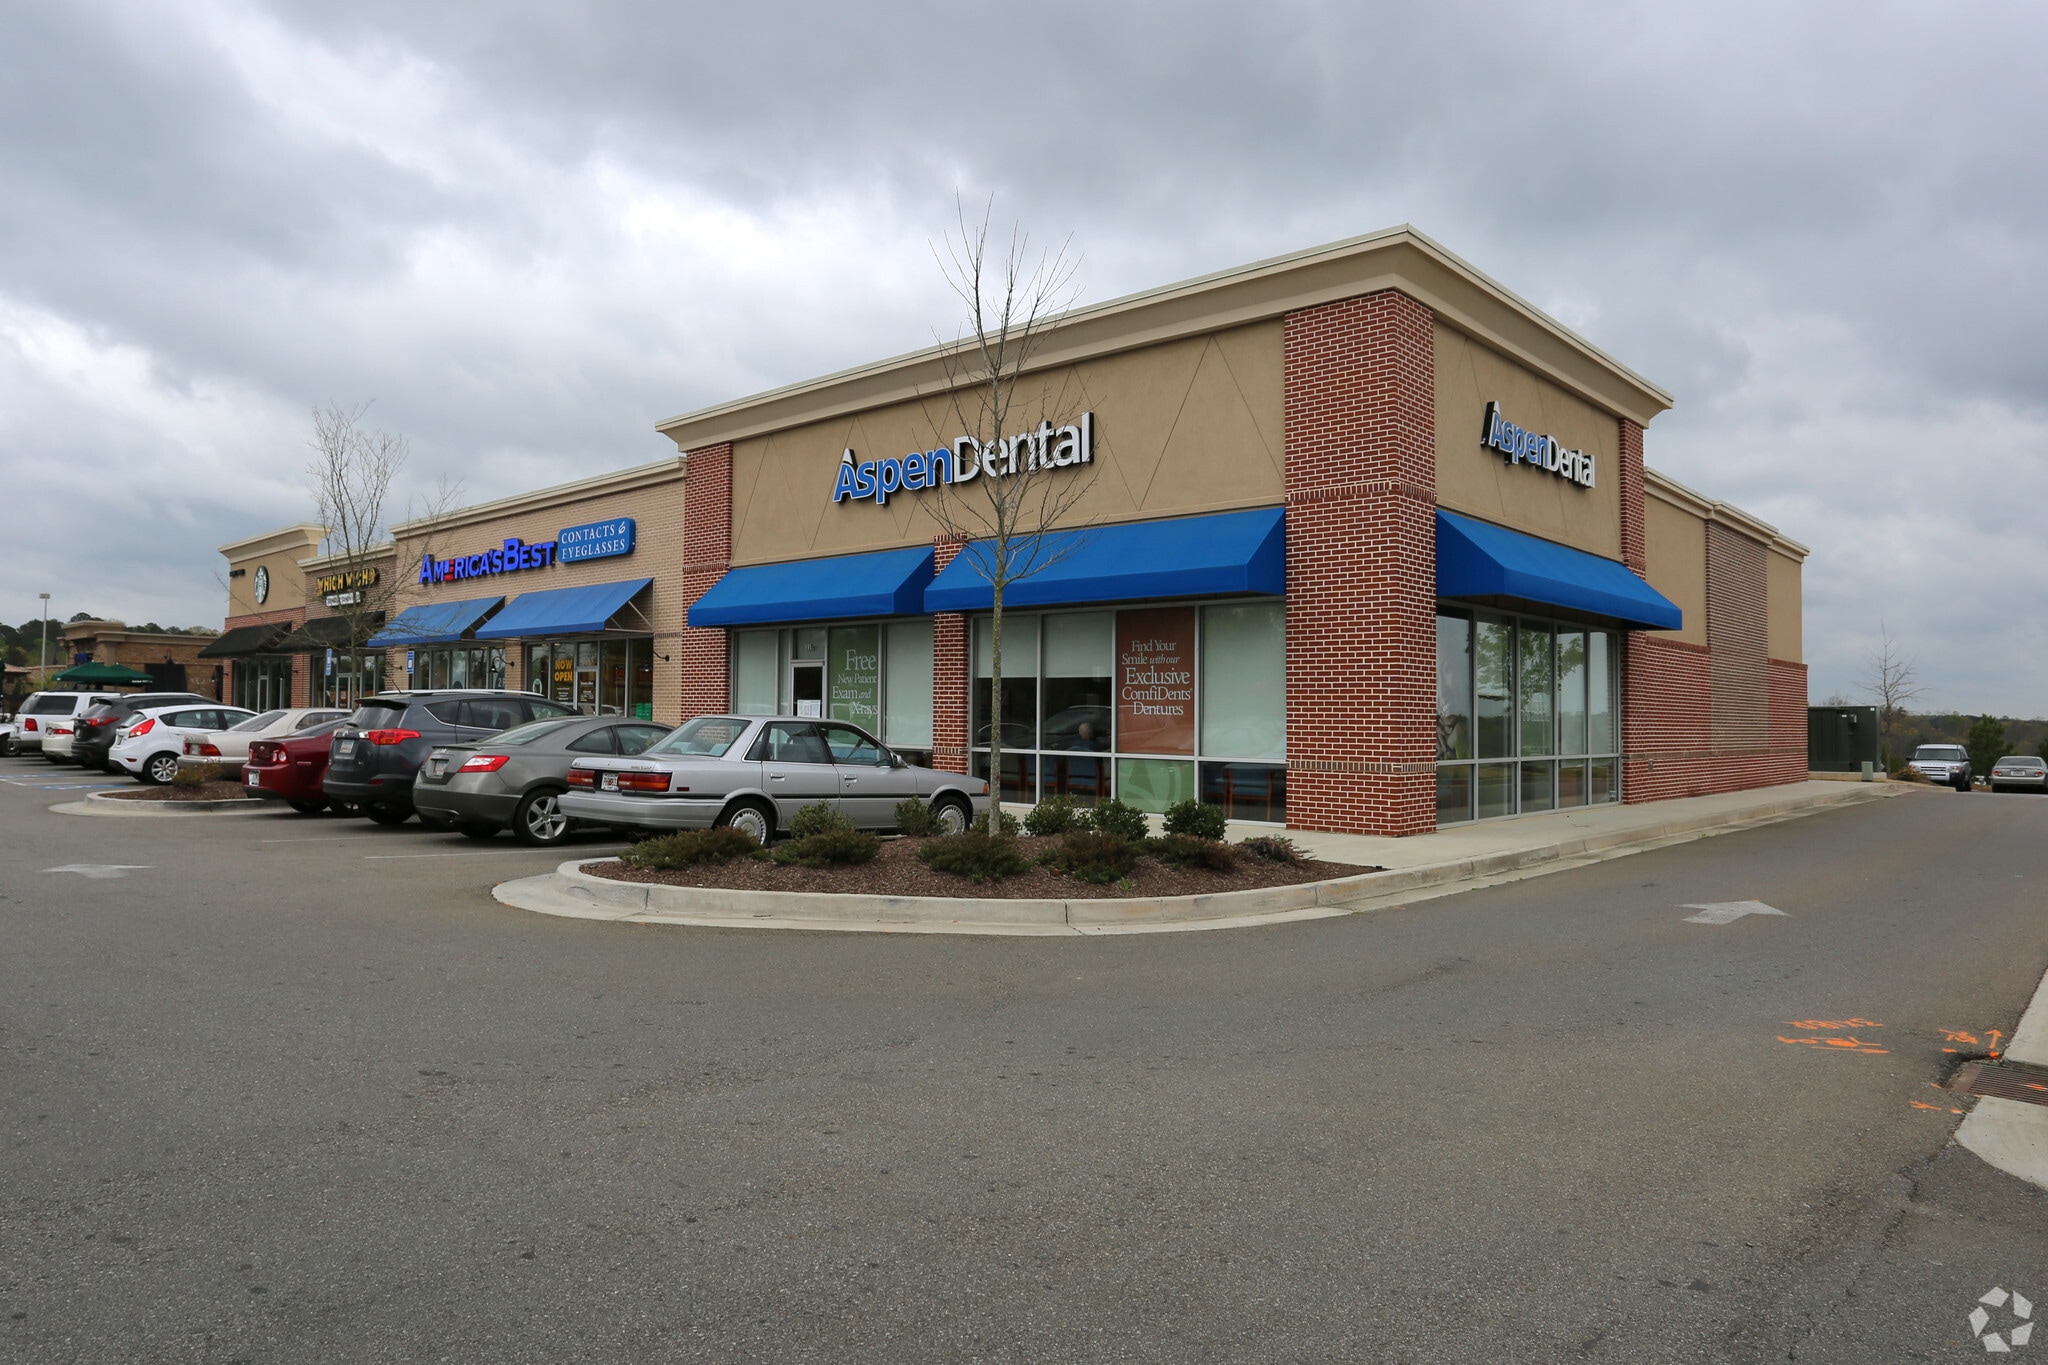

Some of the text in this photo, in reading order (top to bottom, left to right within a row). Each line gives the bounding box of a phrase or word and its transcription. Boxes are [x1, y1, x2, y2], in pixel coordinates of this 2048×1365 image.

[561, 521, 626, 544] CONTACTS &
[562, 538, 625, 560] EYEGLASSES
[317, 568, 369, 596] WHICH WCH
[1132, 639, 1176, 652] Find Your
[555, 660, 573, 670] NOW
[845, 649, 877, 671] Free
[1122, 652, 1180, 665] Smile with our
[554, 671, 573, 682] OPEN
[837, 673, 877, 684] New Patient
[1125, 665, 1191, 685] Exclusive
[832, 686, 872, 699] Exam and
[1133, 701, 1184, 716] Dentures
